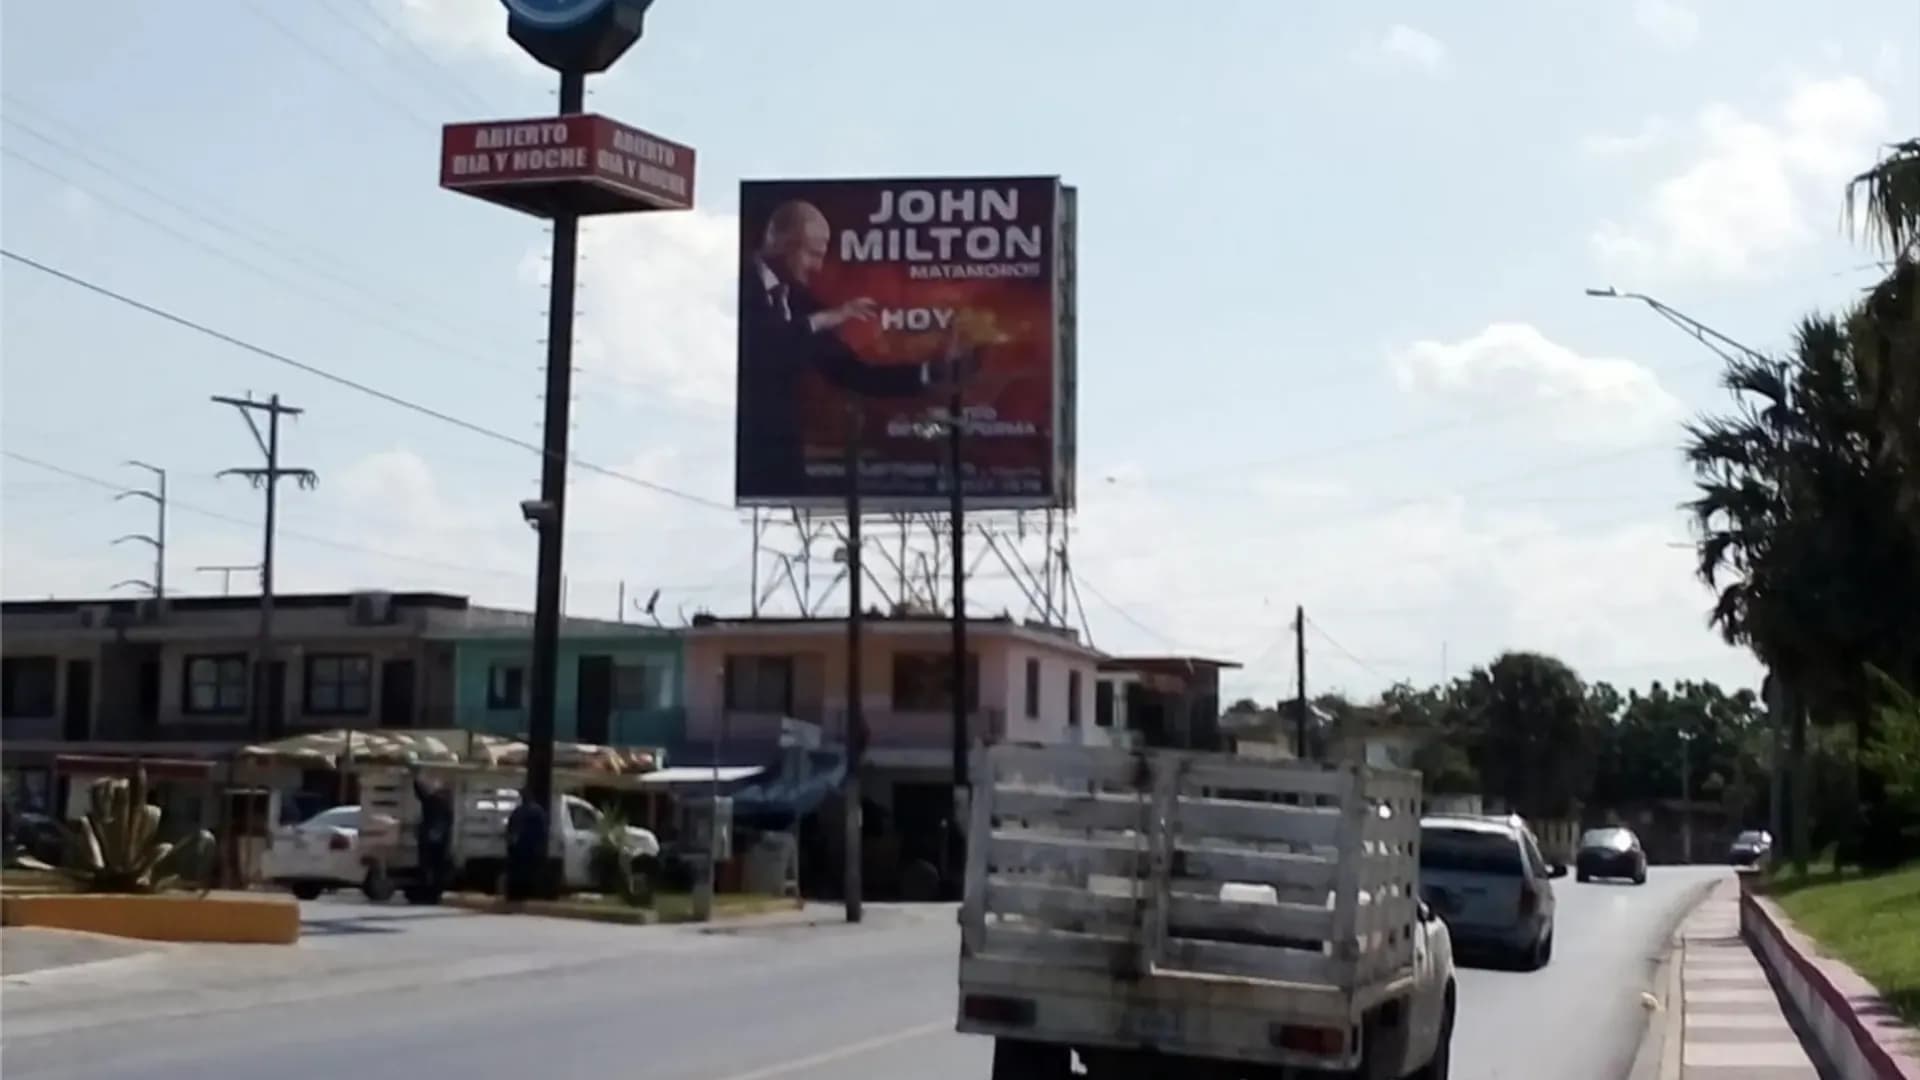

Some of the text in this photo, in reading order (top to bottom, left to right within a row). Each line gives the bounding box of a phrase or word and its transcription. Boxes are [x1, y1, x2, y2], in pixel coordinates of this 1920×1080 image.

[475, 123, 568, 148] ABIERTO
[495, 152, 509, 172] Y
[513, 147, 587, 170] NOCHE
[613, 129, 675, 168] ABIERTO
[627, 159, 638, 179] Y
[869, 188, 1019, 224] JOHN
[840, 225, 1042, 262] MILTON
[909, 263, 1041, 280] MATAMOROS
[881, 308, 954, 331] HOY
